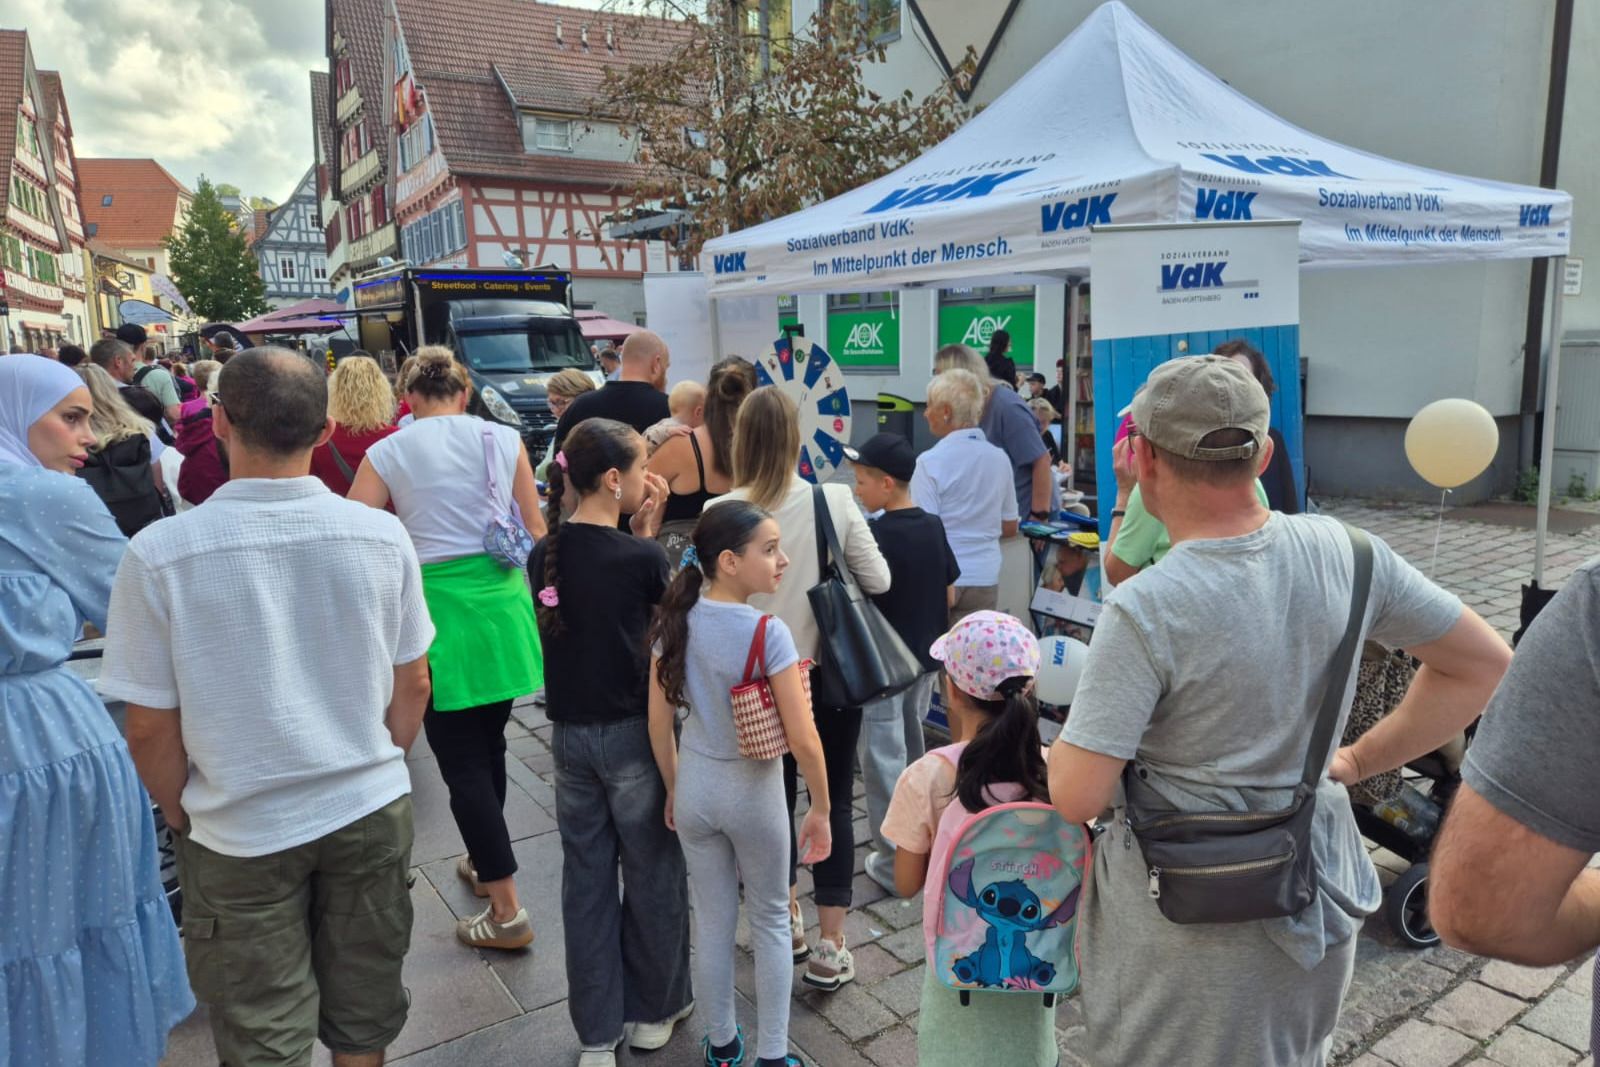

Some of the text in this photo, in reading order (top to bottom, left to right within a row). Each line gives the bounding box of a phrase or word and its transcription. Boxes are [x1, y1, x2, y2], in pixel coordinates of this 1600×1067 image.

[905, 153, 1057, 184] SOZIALVERBAND
[1198, 153, 1363, 181] VdK
[863, 167, 1039, 214] VdK
[1041, 179, 1122, 199] SOZIALVERBAND
[1318, 187, 1444, 212] Sozialverband VdK:
[1041, 191, 1119, 233] VdK
[1194, 187, 1259, 220] VdK
[1519, 204, 1553, 228] VdK
[786, 217, 914, 253] Sozialverband VdK:
[1344, 222, 1363, 242] Im
[1365, 223, 1437, 246] Mittelpunkt
[1438, 225, 1458, 242] der
[713, 251, 747, 275] VdK
[813, 236, 1013, 277] Im Mittelpunkt der Mensch.
[1160, 249, 1230, 260] SOZIALVERBAND
[431, 280, 477, 290] Streetfood
[483, 281, 519, 292] Catering
[523, 282, 552, 291] Events
[1160, 261, 1228, 291] VdK
[844, 322, 884, 348] AOK
[1053, 640, 1066, 666] VdK
[991, 860, 1039, 876] STITCH
